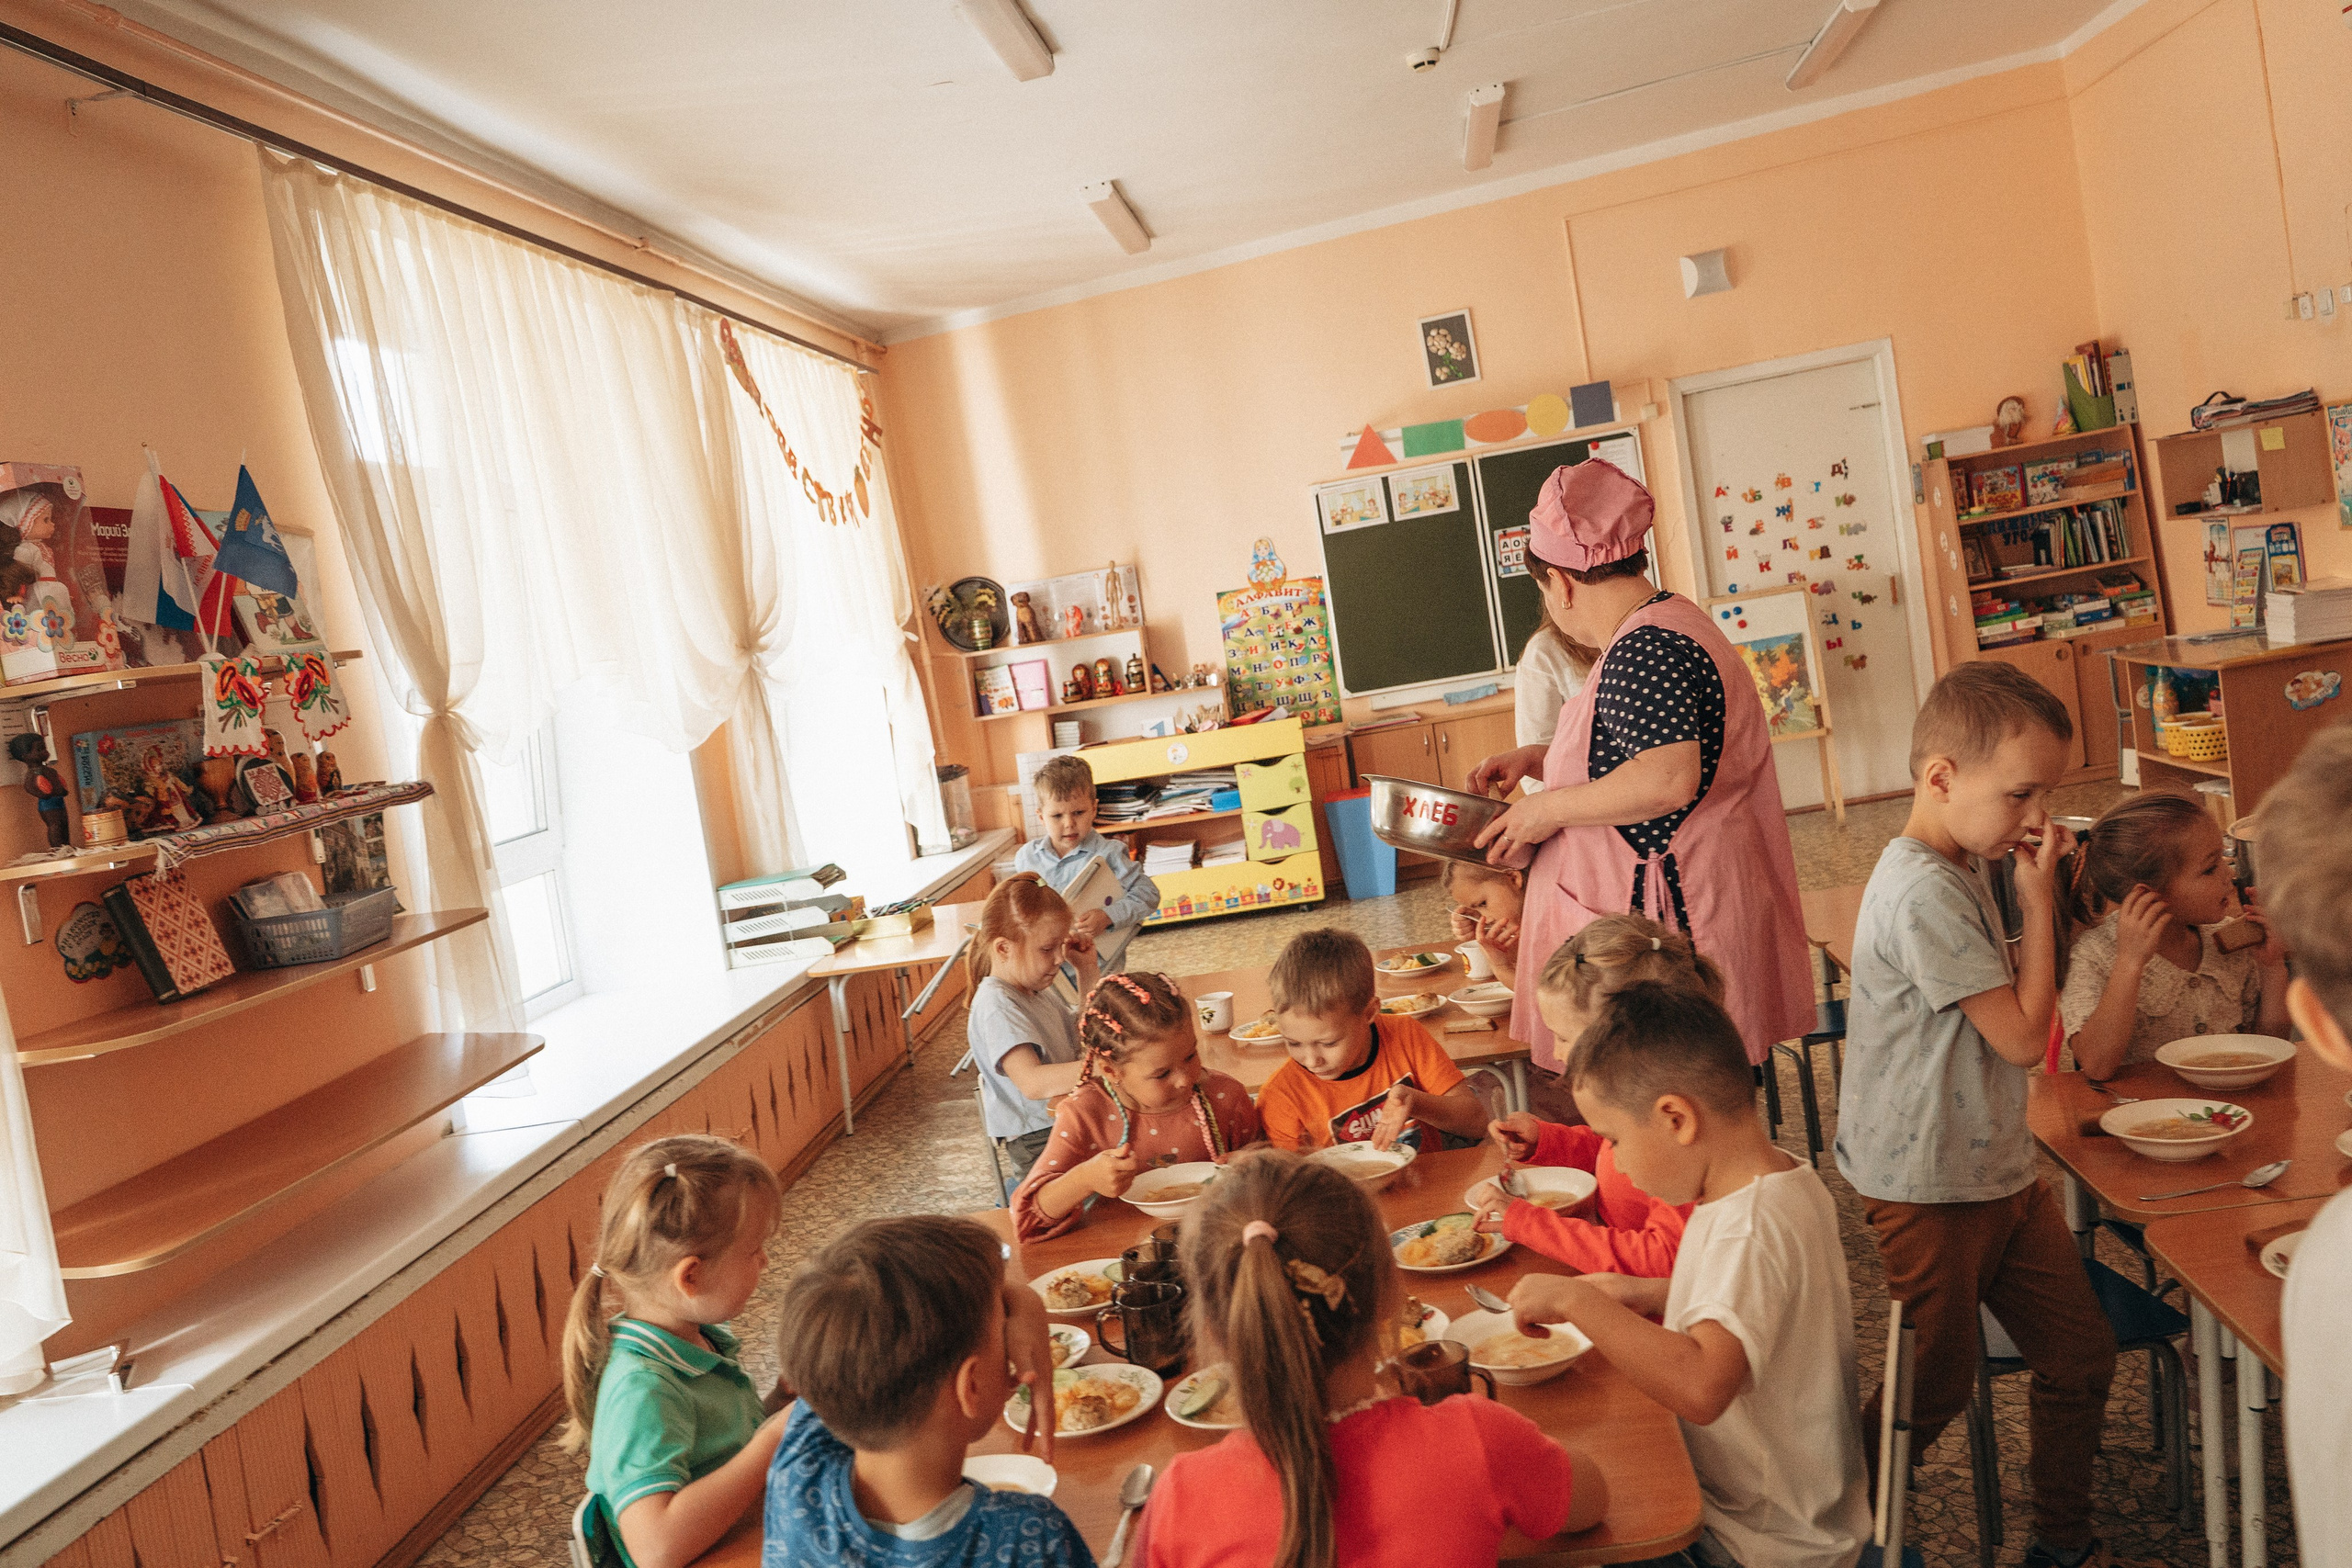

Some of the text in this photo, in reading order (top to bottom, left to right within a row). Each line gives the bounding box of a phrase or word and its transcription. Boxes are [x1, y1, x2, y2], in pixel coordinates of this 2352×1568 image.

[1831, 463, 1844, 477] Д
[1715, 486, 1727, 498] А
[1781, 477, 1792, 489] В
[1776, 504, 1791, 517] Ж
[1724, 522, 1734, 533] Е
[1807, 518, 1816, 530] З
[1502, 539, 1521, 549] А О
[1504, 555, 1511, 563] Я
[1726, 545, 1739, 561] Й
[1758, 560, 1772, 573] К
[1788, 572, 1797, 584] Р
[1236, 588, 1303, 607] АЛФАВИТ
[1240, 603, 1294, 619] А Б В
[1226, 617, 1317, 640] Г Д Е Ё Ж
[1227, 649, 1237, 659] З
[1249, 645, 1259, 655] И
[1288, 639, 1298, 649] К
[1308, 636, 1317, 646] Л
[1826, 637, 1843, 650] Ы
[1230, 653, 1320, 676] М Н О П Р
[1233, 672, 1323, 694] С Т У Ф Х
[1255, 700, 1265, 709] Ч
[1276, 696, 1290, 706] Ш
[1298, 693, 1313, 704] Щ
[1321, 690, 1332, 699] Ъ
[1318, 708, 1327, 717] Я
[1150, 721, 1165, 737] 1
[1403, 795, 1459, 827] ХЛЕБ
